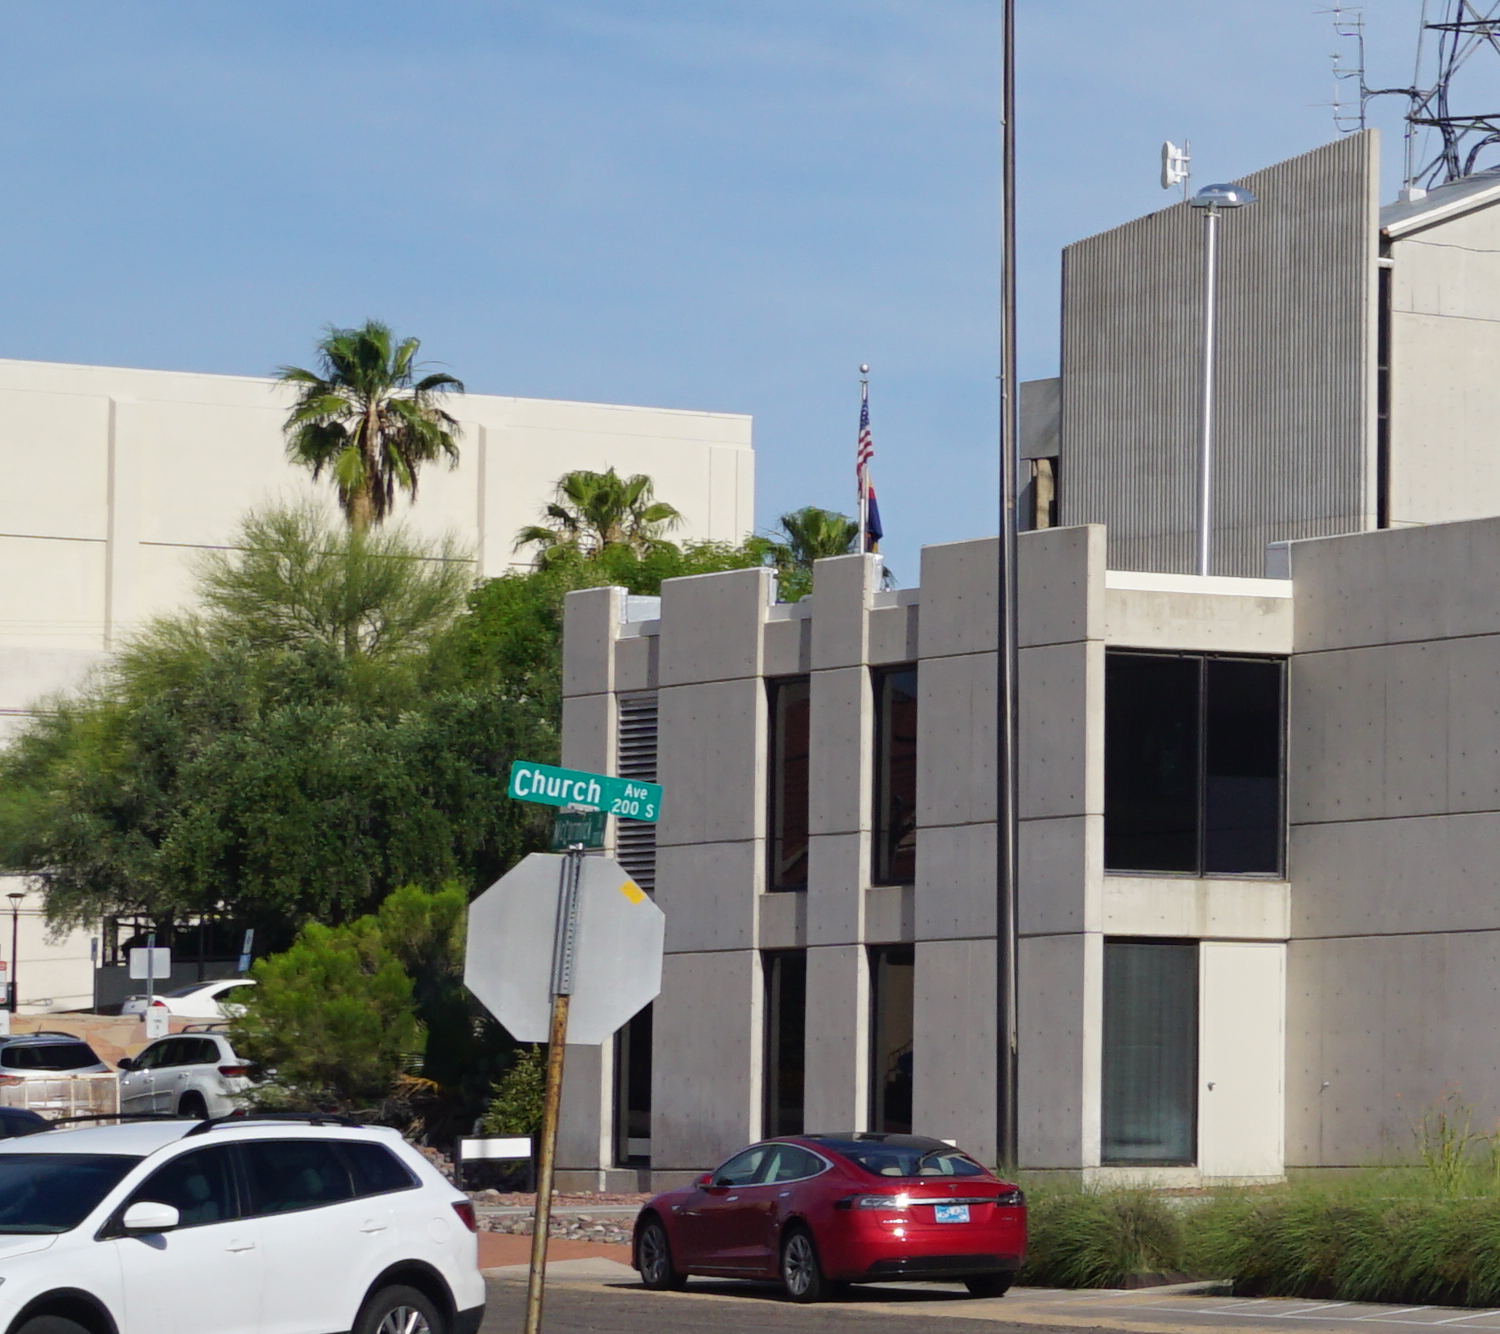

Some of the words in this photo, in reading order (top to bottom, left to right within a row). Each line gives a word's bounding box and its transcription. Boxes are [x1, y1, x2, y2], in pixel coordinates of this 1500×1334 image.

[514, 768, 602, 804] Church
[624, 783, 648, 800] Ave
[612, 798, 639, 816] 200
[645, 803, 654, 818] S
